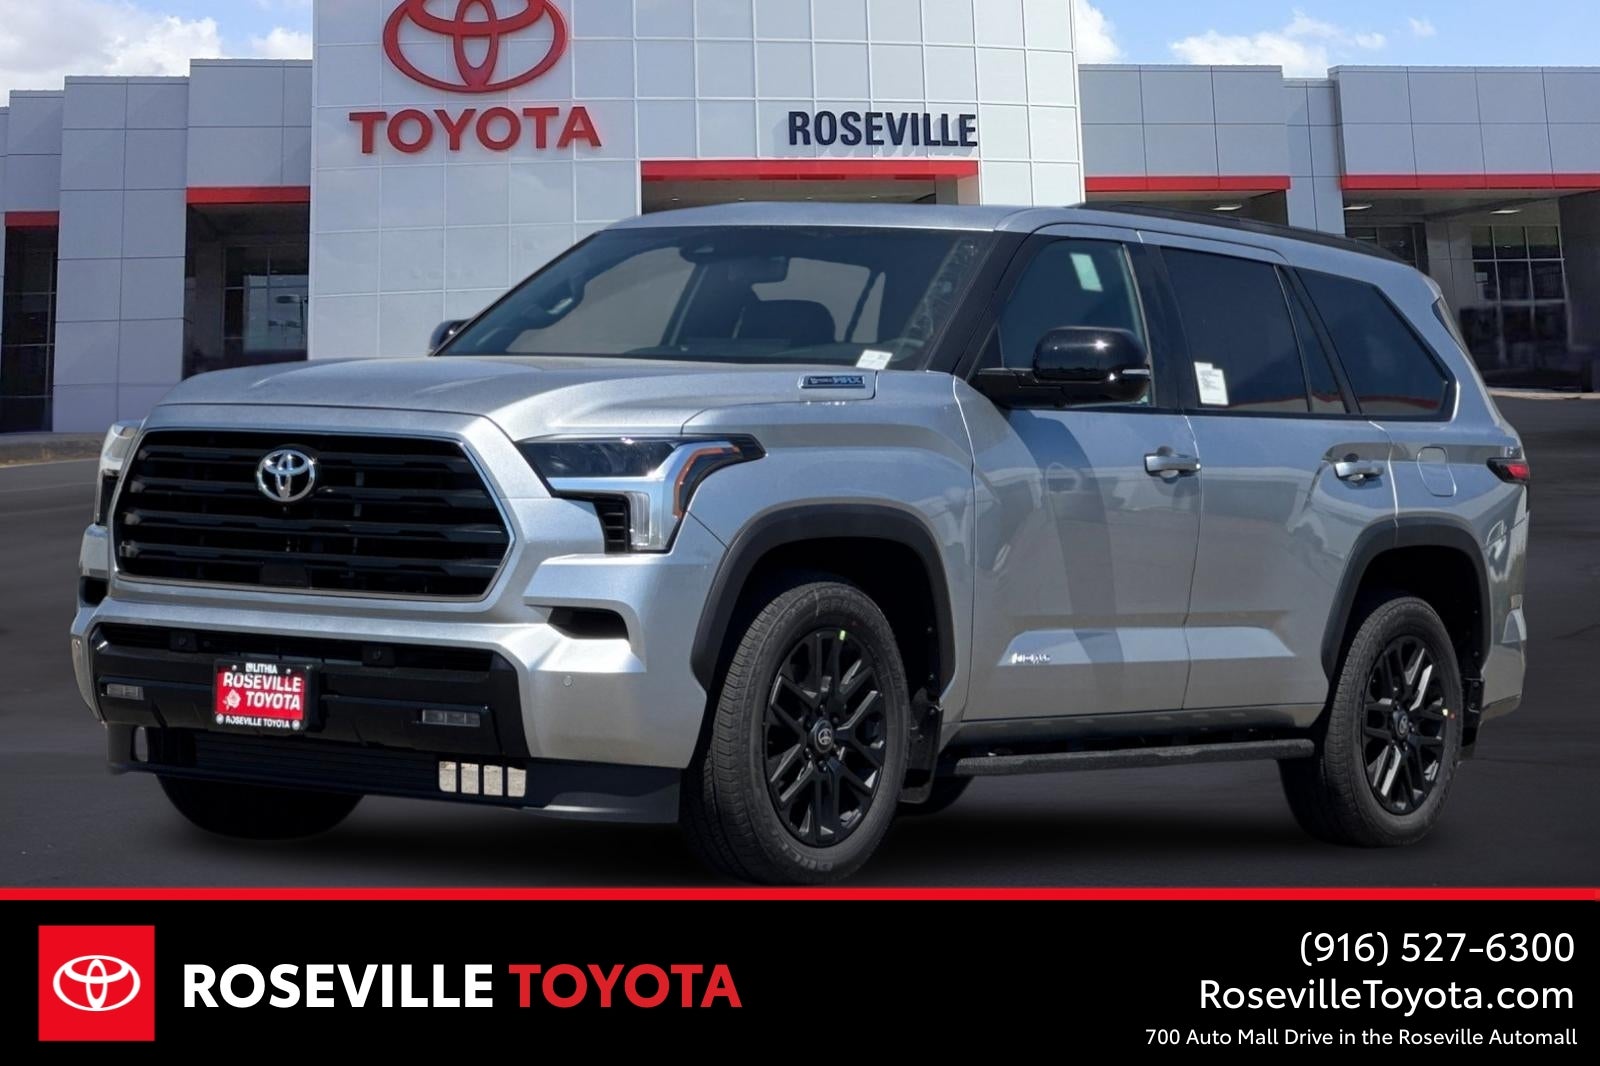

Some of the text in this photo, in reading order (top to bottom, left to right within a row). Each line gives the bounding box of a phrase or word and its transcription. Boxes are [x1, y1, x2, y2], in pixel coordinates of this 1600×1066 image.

[349, 106, 602, 154] TOYOTA
[788, 110, 978, 147] ROSEVILLE
[253, 663, 278, 674] LITHIA
[223, 672, 302, 691] ROSEVILLE
[246, 692, 301, 710] TOYOTA
[226, 716, 291, 729] ROSEVILLE TOYOTA
